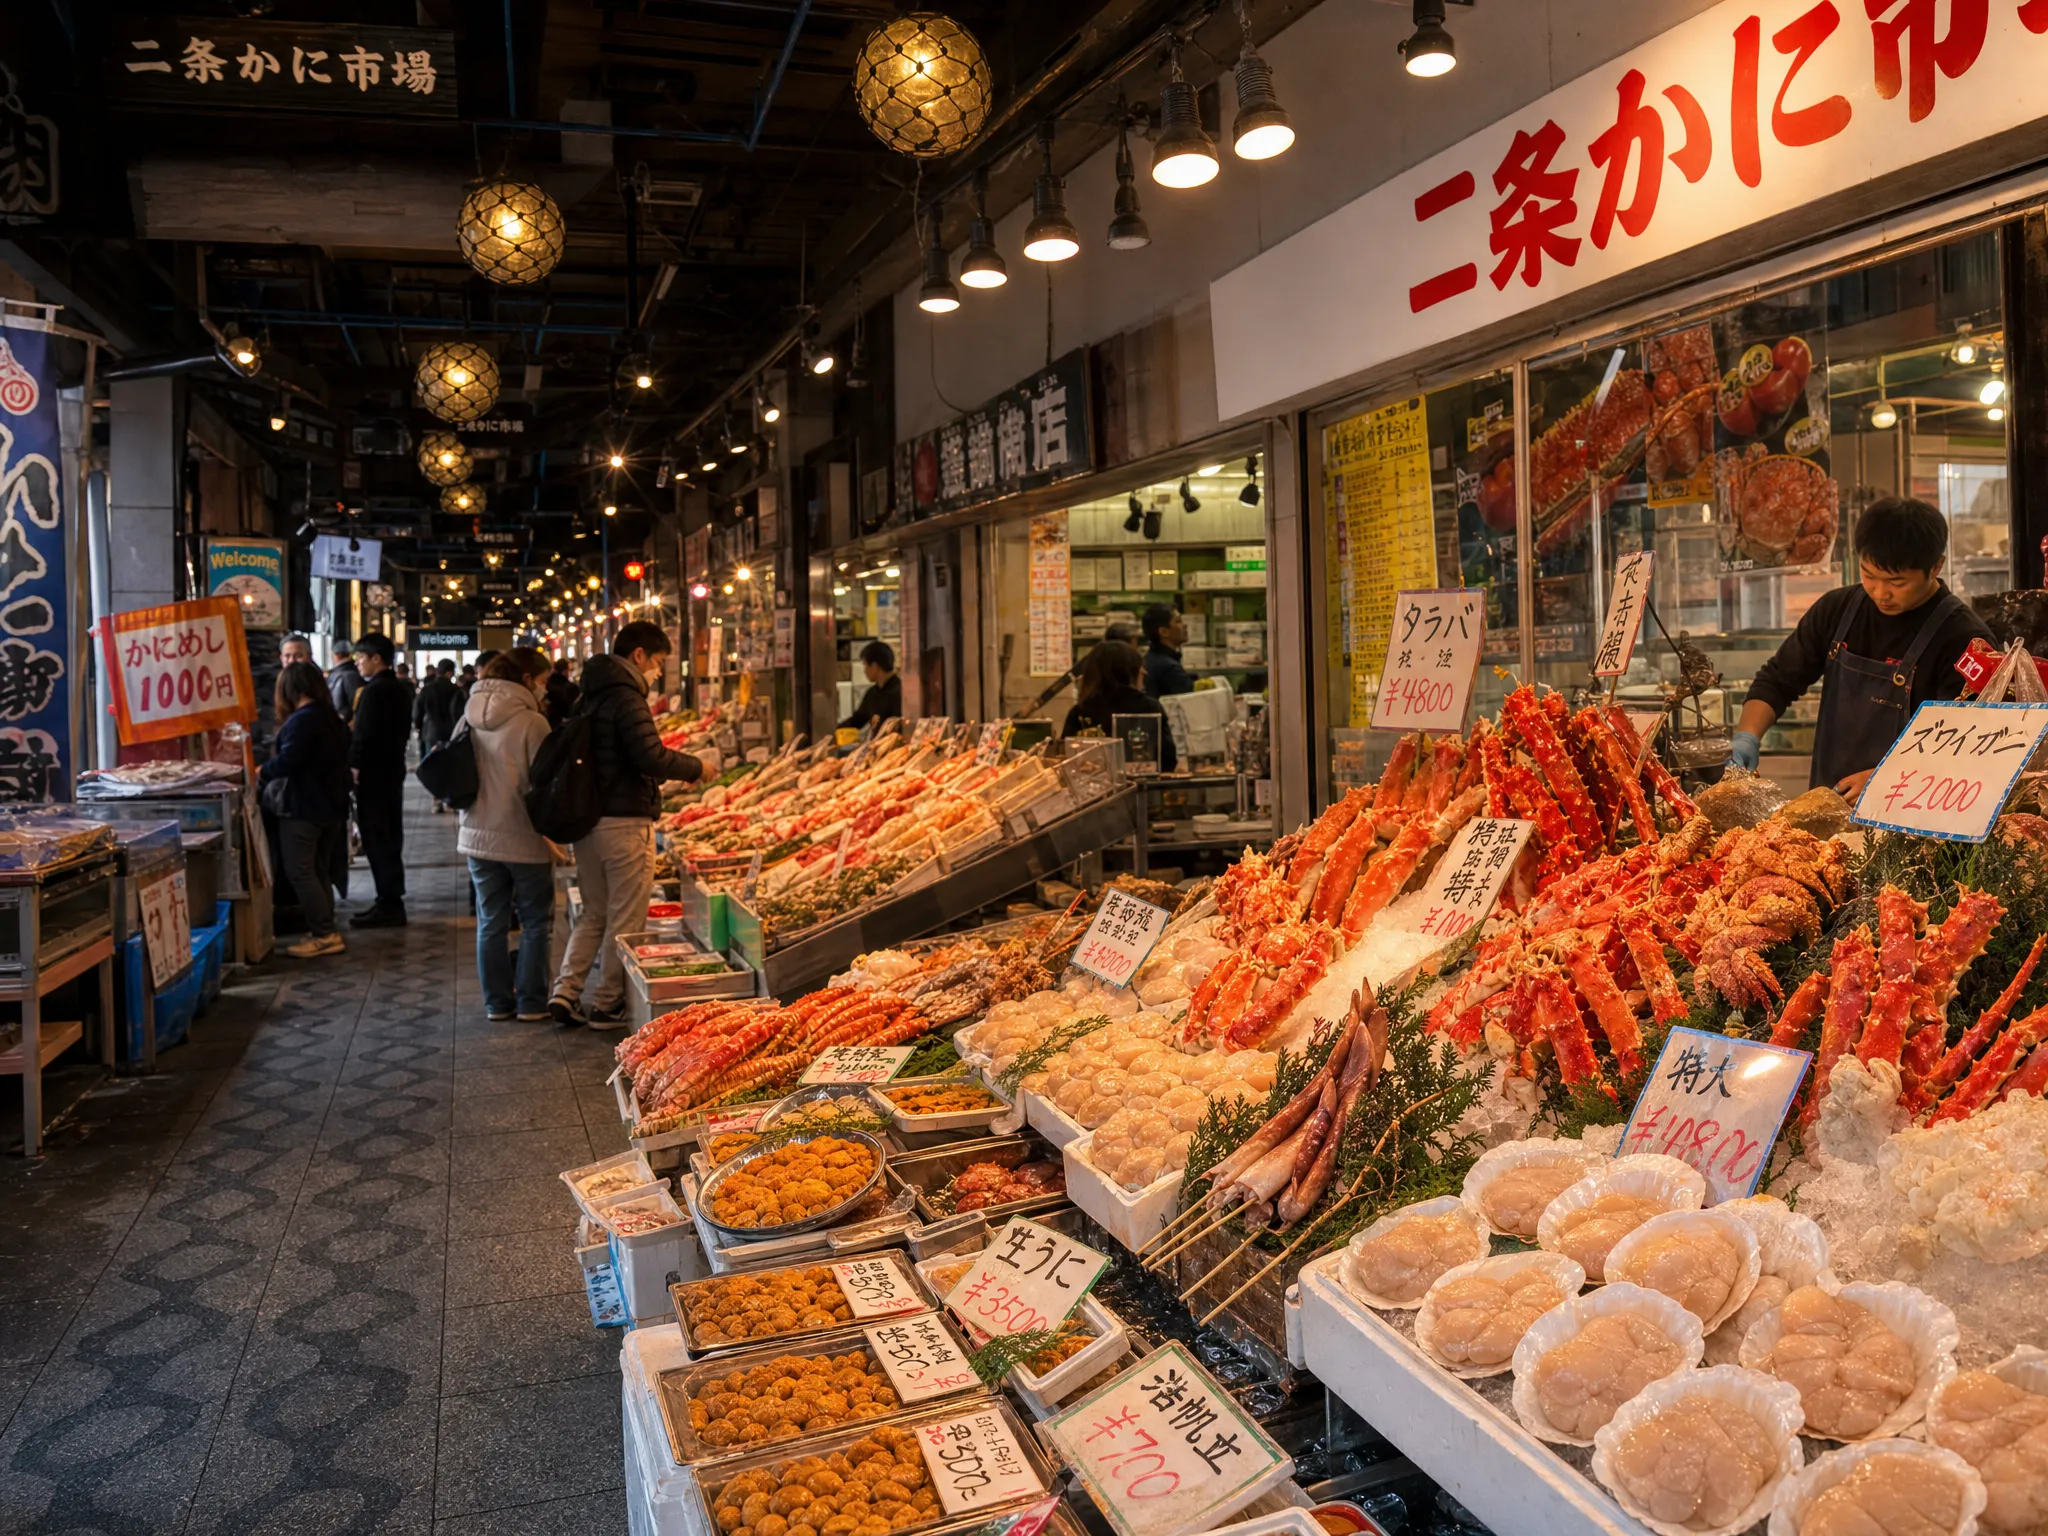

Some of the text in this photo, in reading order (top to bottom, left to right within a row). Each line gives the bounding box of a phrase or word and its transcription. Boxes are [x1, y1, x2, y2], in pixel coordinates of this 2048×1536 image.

[124, 36, 438, 95] 二条かに市場
[1409, 0, 2048, 313] 二条かに市
[210, 551, 279, 570] Welcome
[419, 632, 469, 645] Welcome
[1402, 602, 1475, 643] タラバ
[125, 626, 226, 668] かにめし
[140, 665, 234, 711] 1000円
[1384, 677, 1454, 717] ¥4800
[1900, 719, 2026, 757] ズワイガニ
[1885, 769, 1983, 813] ¥2000
[1667, 1045, 1738, 1098] 特大
[995, 1226, 1086, 1290] 生うに
[963, 1271, 1048, 1334] ¥3500
[1085, 1404, 1181, 1500] ¥700
